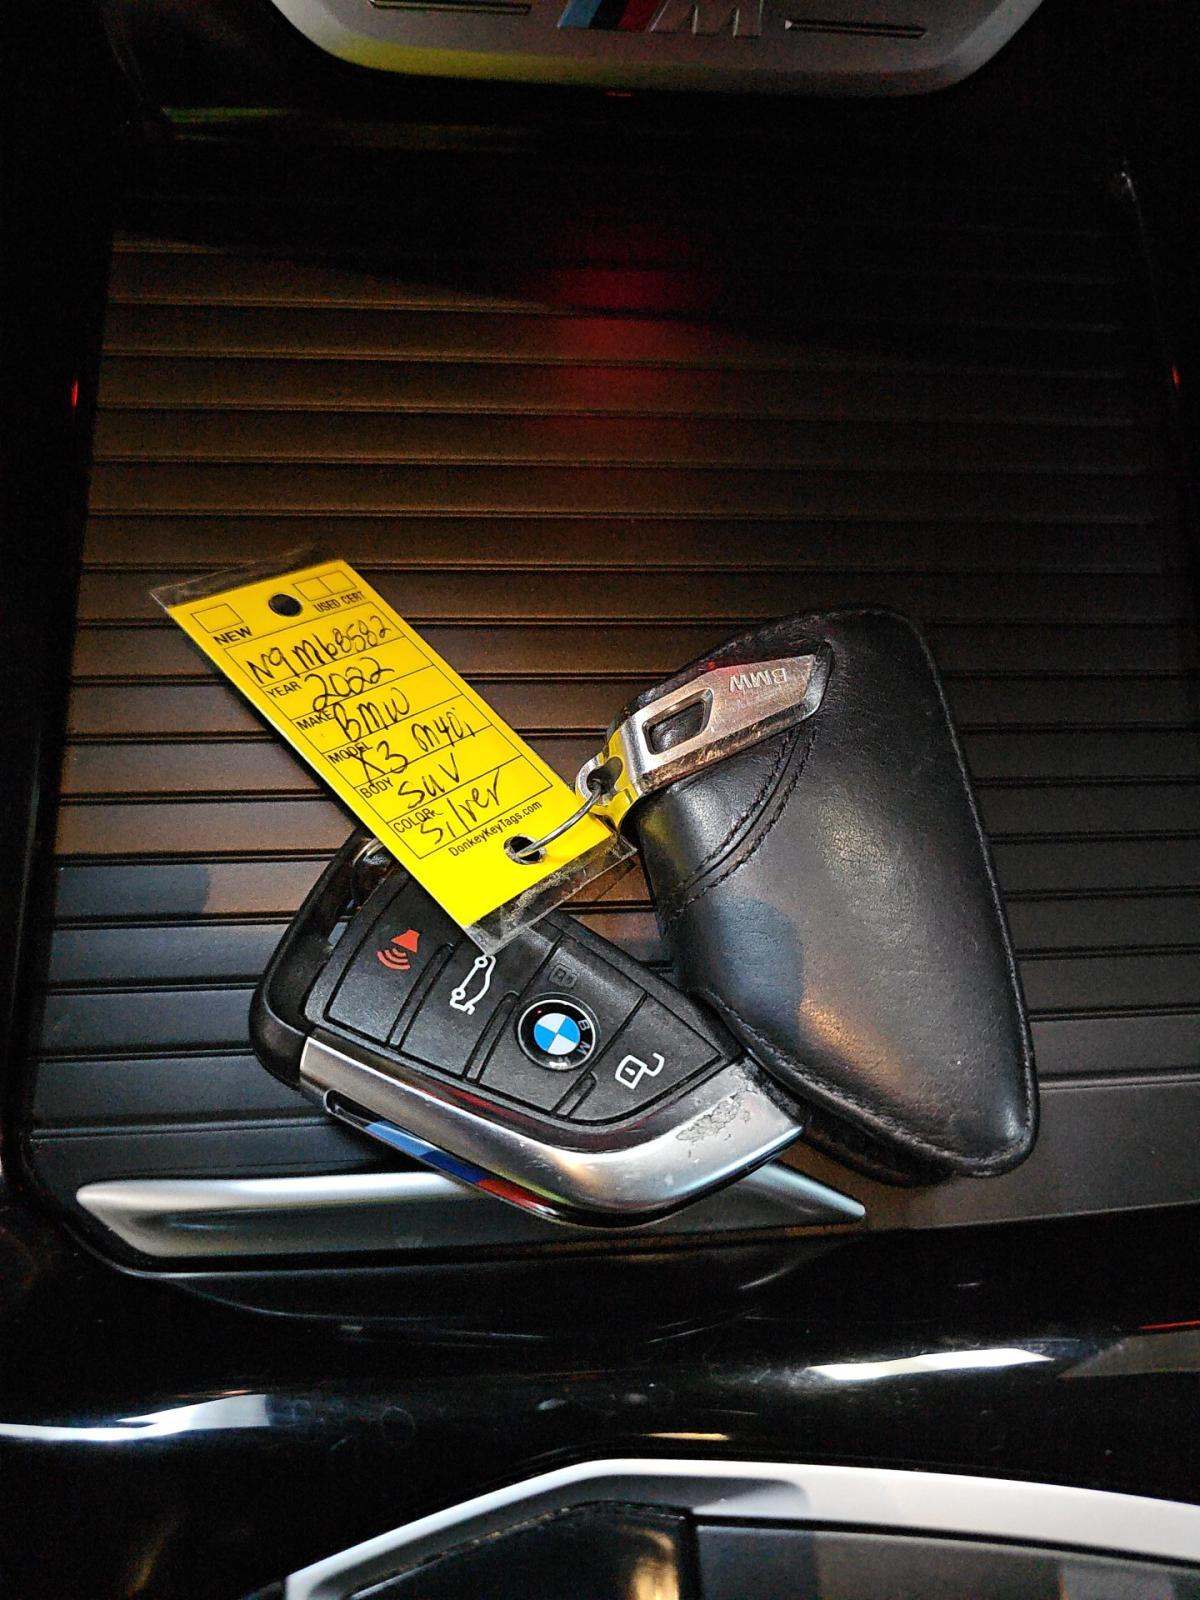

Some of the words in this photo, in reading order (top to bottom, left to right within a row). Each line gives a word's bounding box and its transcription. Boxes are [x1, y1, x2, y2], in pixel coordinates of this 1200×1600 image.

[313, 598, 341, 613] USED
[340, 590, 366, 605] CERT
[213, 626, 254, 646] NEW
[266, 680, 302, 699] YEAR
[304, 656, 395, 713] 2022
[729, 667, 788, 694] BMW
[298, 708, 334, 732] MAKE
[333, 687, 411, 742] BMW
[328, 741, 374, 765] MODEL
[348, 740, 409, 787] X3
[360, 776, 394, 799] BODY
[393, 807, 436, 834] COLOR
[448, 801, 543, 857] DonkeyKeyTags.com
